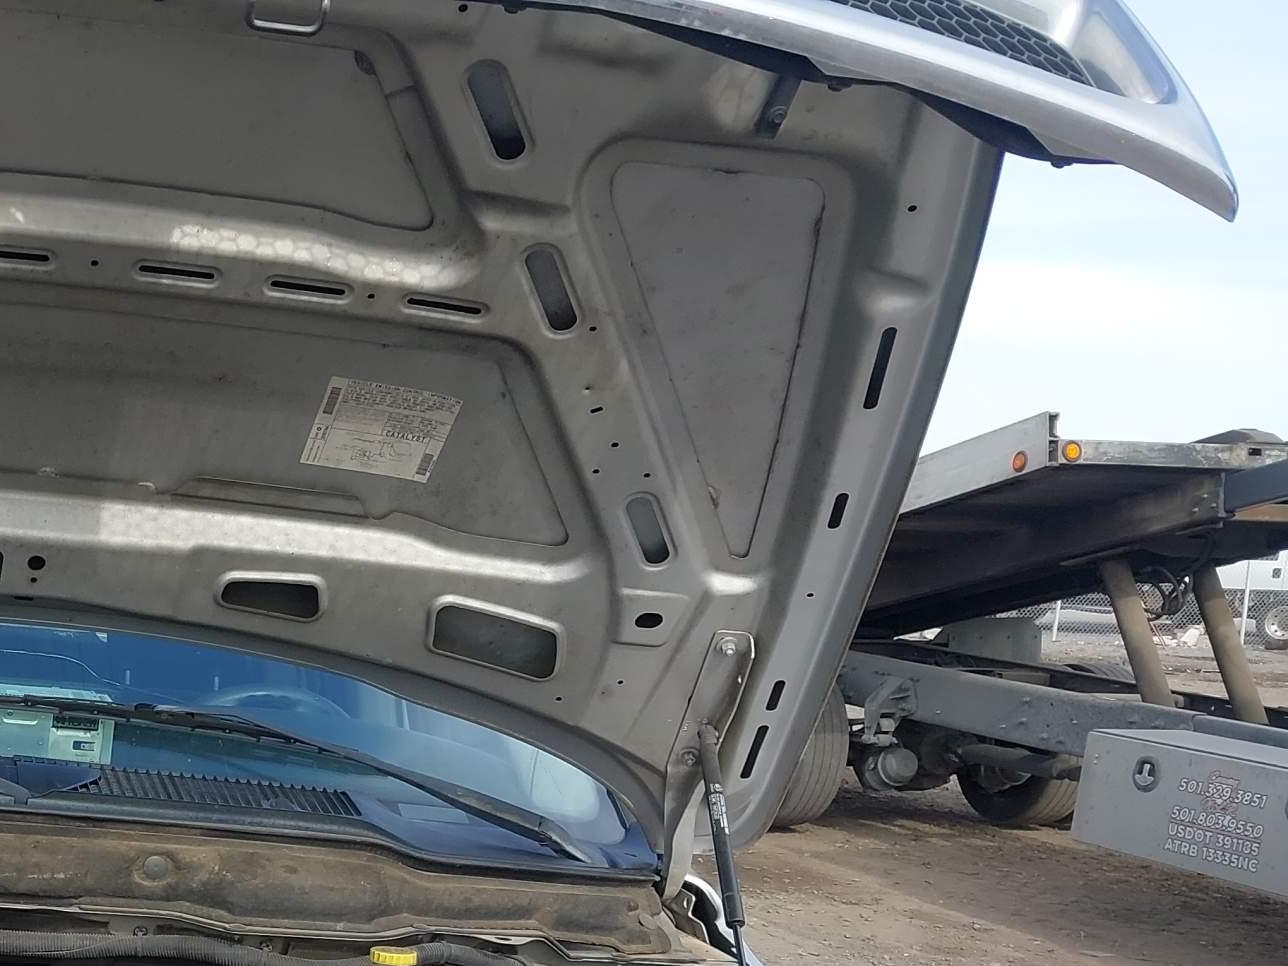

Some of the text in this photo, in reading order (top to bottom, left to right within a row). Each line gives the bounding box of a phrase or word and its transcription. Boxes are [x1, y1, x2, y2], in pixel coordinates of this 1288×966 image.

[385, 430, 426, 443] CATALYST
[1178, 778, 1268, 808] 501.329.3851
[1171, 806, 1263, 838] 501.803.9550
[1168, 823, 1213, 844] USDOT
[1164, 839, 1198, 857] ATRB
